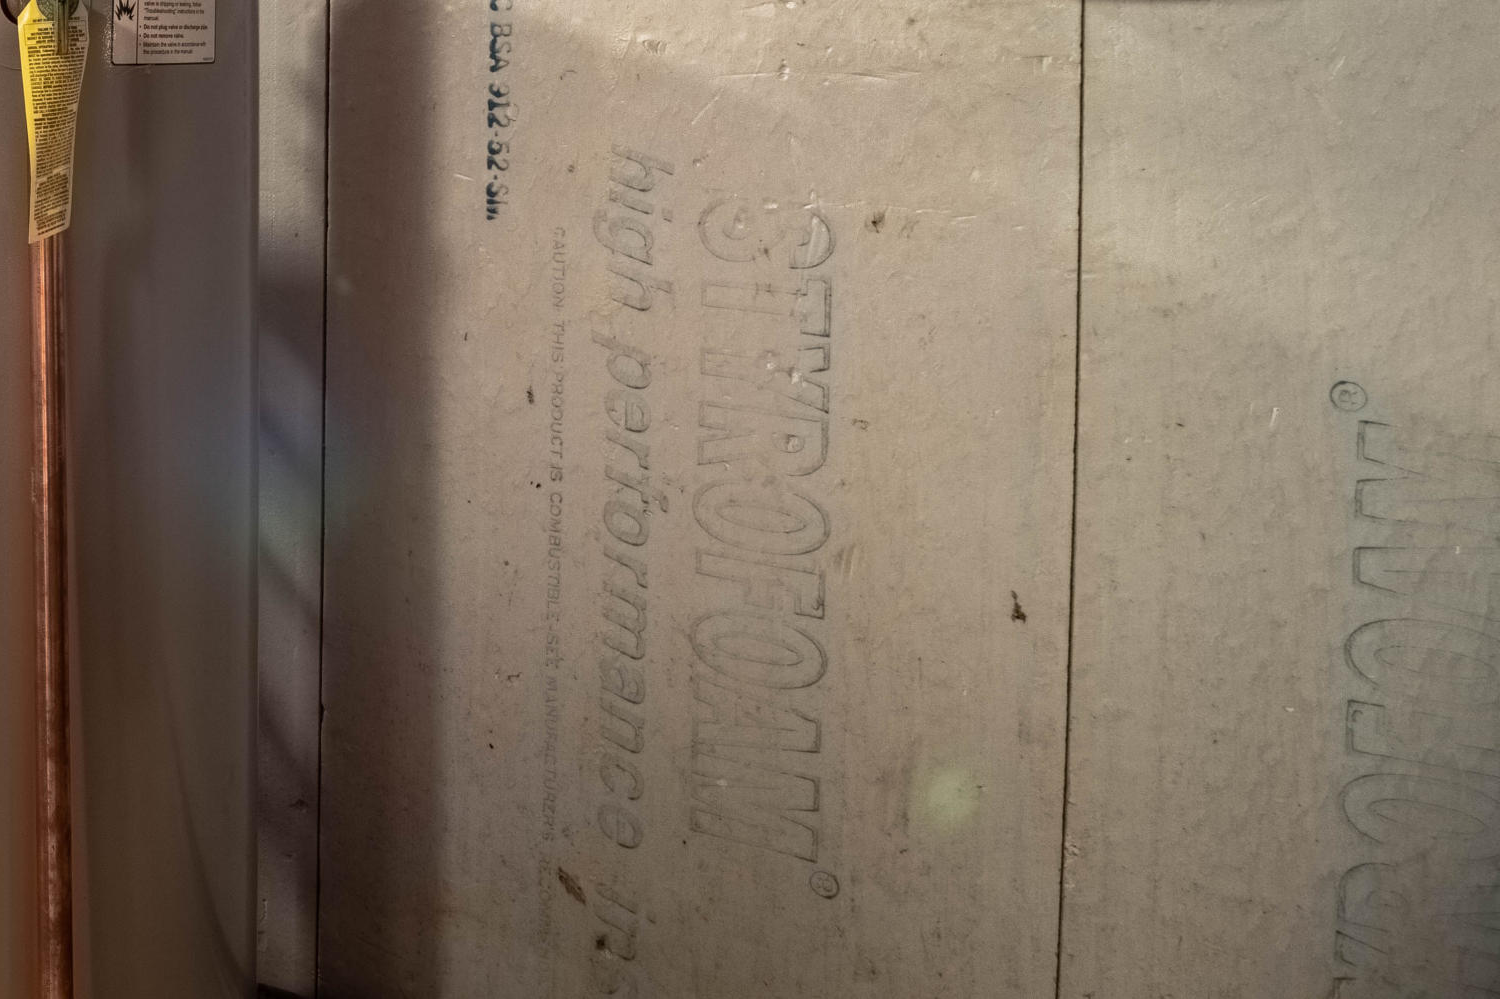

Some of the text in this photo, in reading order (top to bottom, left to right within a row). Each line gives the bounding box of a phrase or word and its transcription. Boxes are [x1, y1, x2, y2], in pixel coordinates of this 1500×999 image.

[490, 22, 513, 74] BSA
[593, 143, 674, 312] high
[550, 320, 567, 363] THIS
[549, 371, 566, 459] PRODUCT
[548, 464, 564, 482] IS
[590, 330, 670, 850] performance
